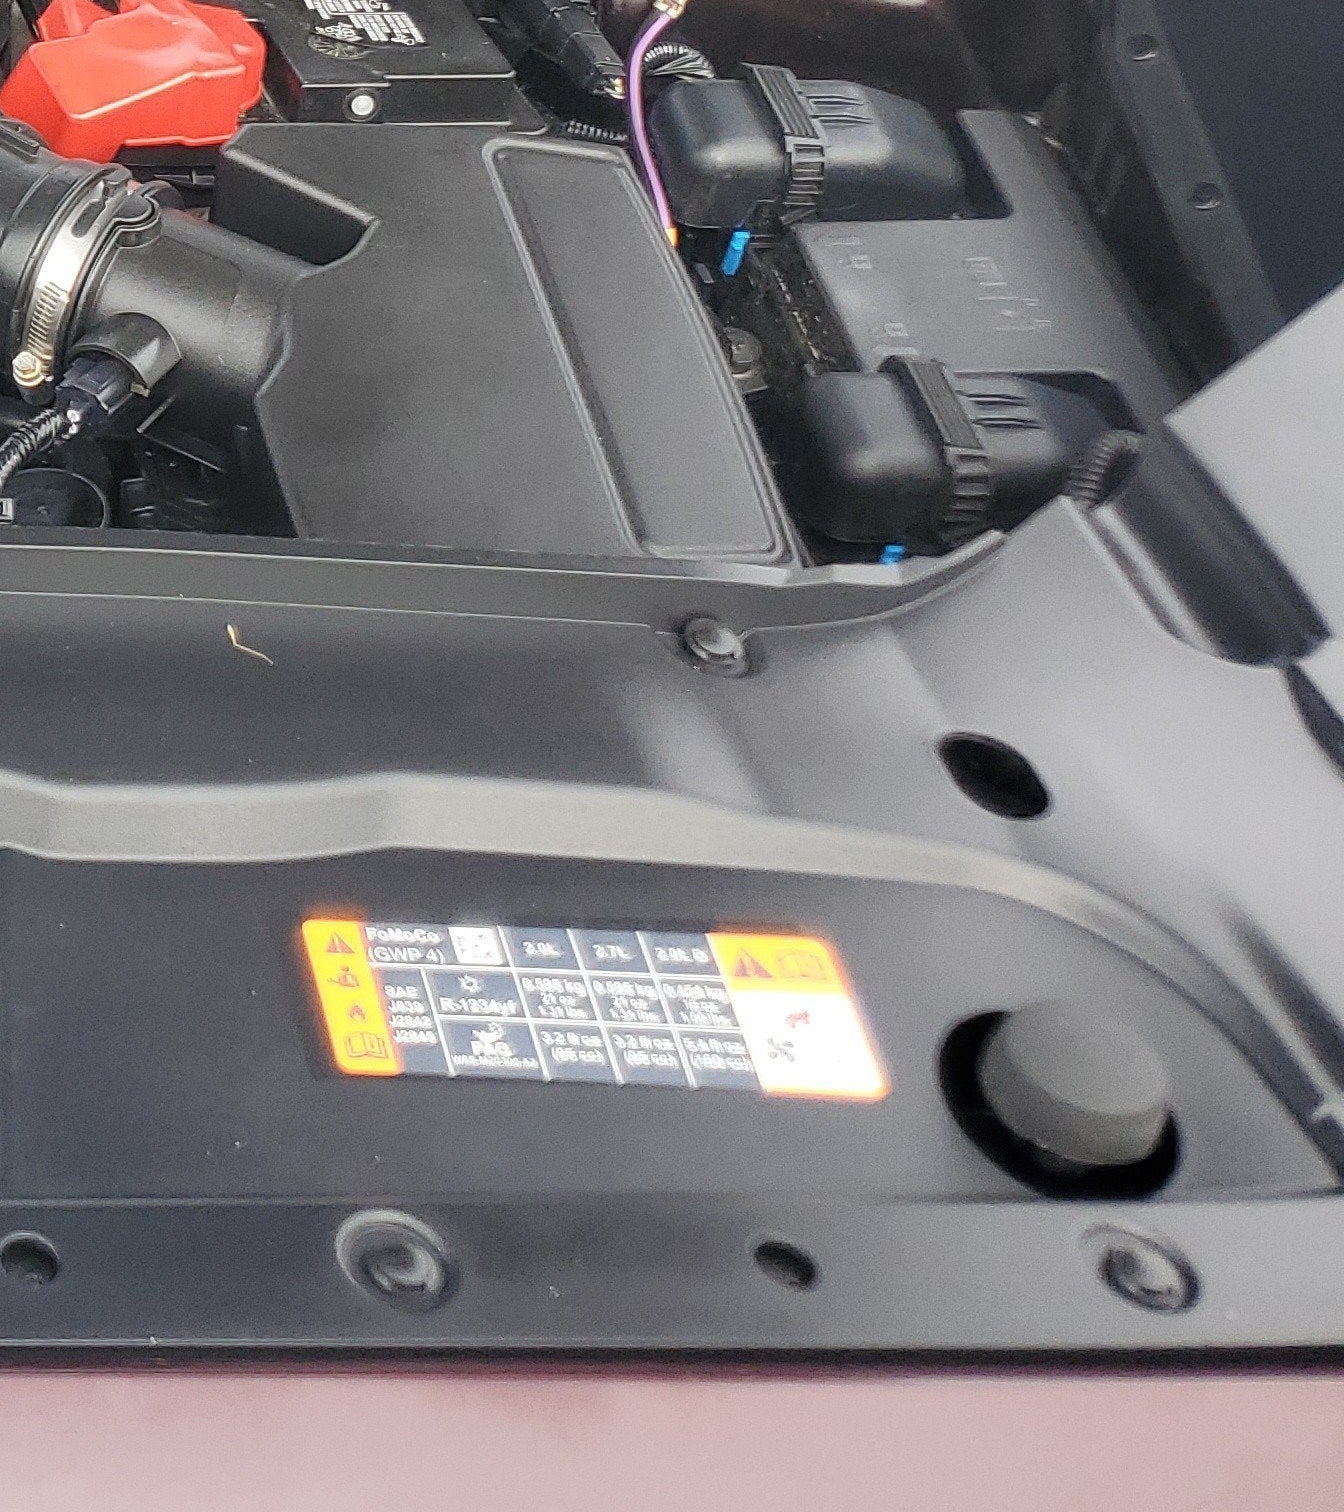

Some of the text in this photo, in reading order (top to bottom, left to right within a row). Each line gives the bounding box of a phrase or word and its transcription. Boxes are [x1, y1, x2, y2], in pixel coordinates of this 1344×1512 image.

[365, 927, 443, 944] FoMoCo
[368, 946, 446, 965] (GWP 4)
[385, 985, 419, 999] SAE
[439, 996, 517, 1017] R-1234yf
